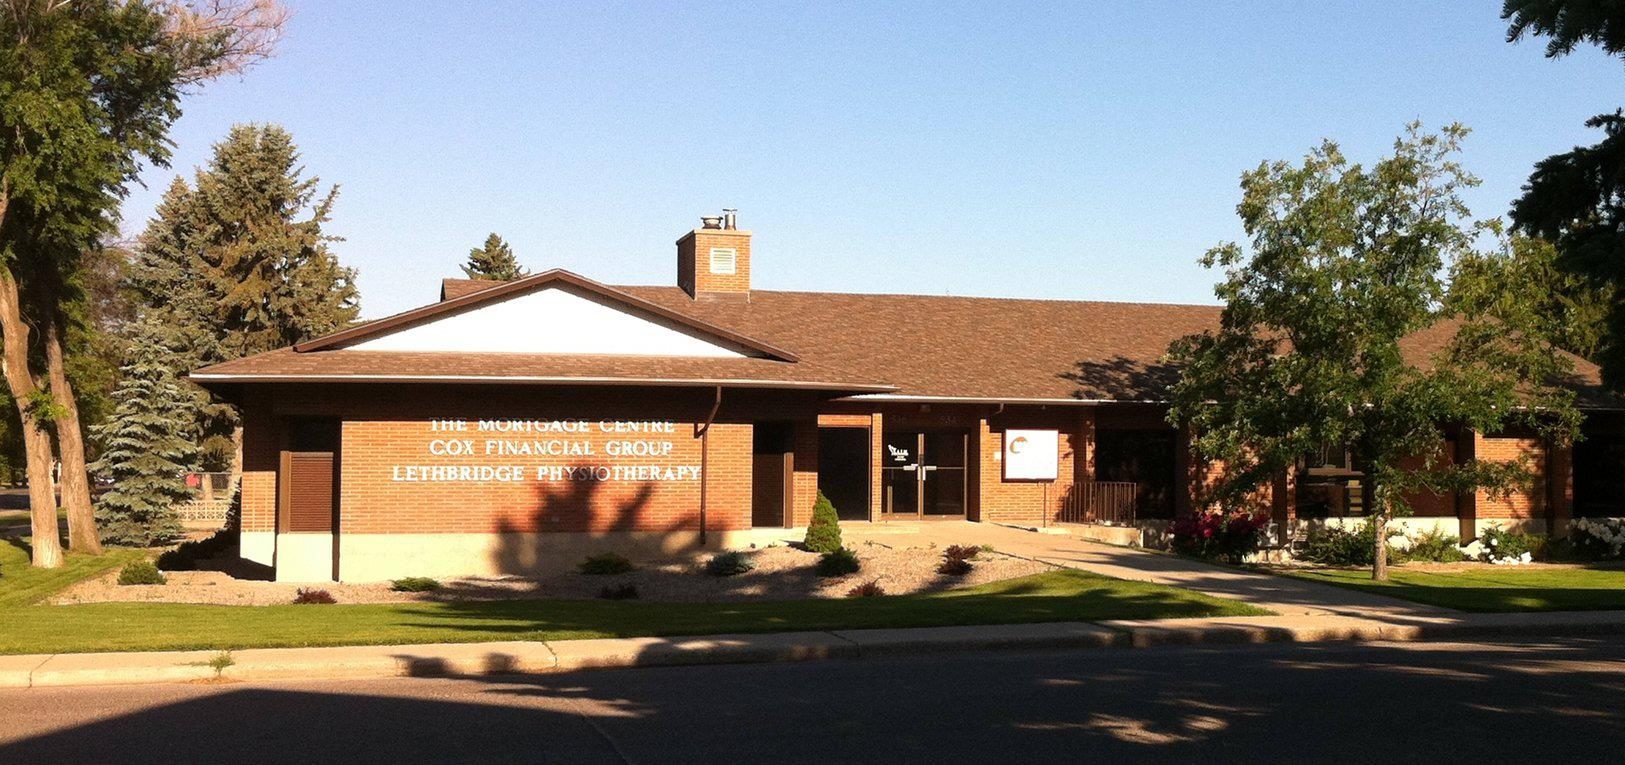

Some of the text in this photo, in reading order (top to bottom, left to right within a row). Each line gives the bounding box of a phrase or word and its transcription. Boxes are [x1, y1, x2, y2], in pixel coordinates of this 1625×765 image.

[429, 417, 675, 432] THE MORTGAGE CENTRE
[429, 439, 673, 456] COX FINANCIAL GROUP
[392, 465, 702, 481] LETHBRIDGE PHYSIOTHERAPY
